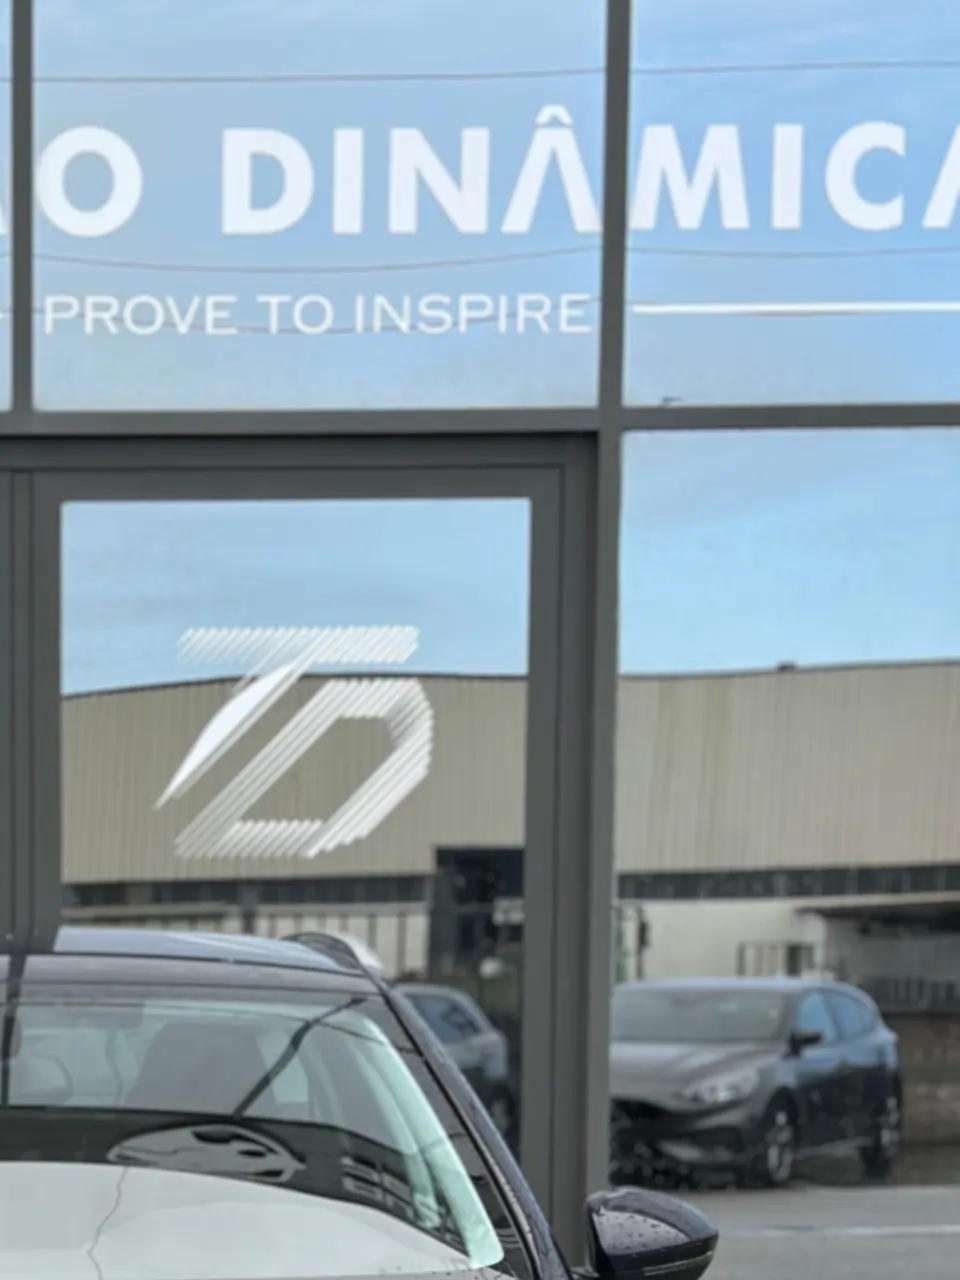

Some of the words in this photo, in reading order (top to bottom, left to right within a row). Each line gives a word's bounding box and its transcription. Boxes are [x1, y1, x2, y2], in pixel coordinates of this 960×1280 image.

[43, 293, 238, 335] PROVE
[257, 293, 334, 335] TO
[355, 292, 592, 334] INSPIRE
